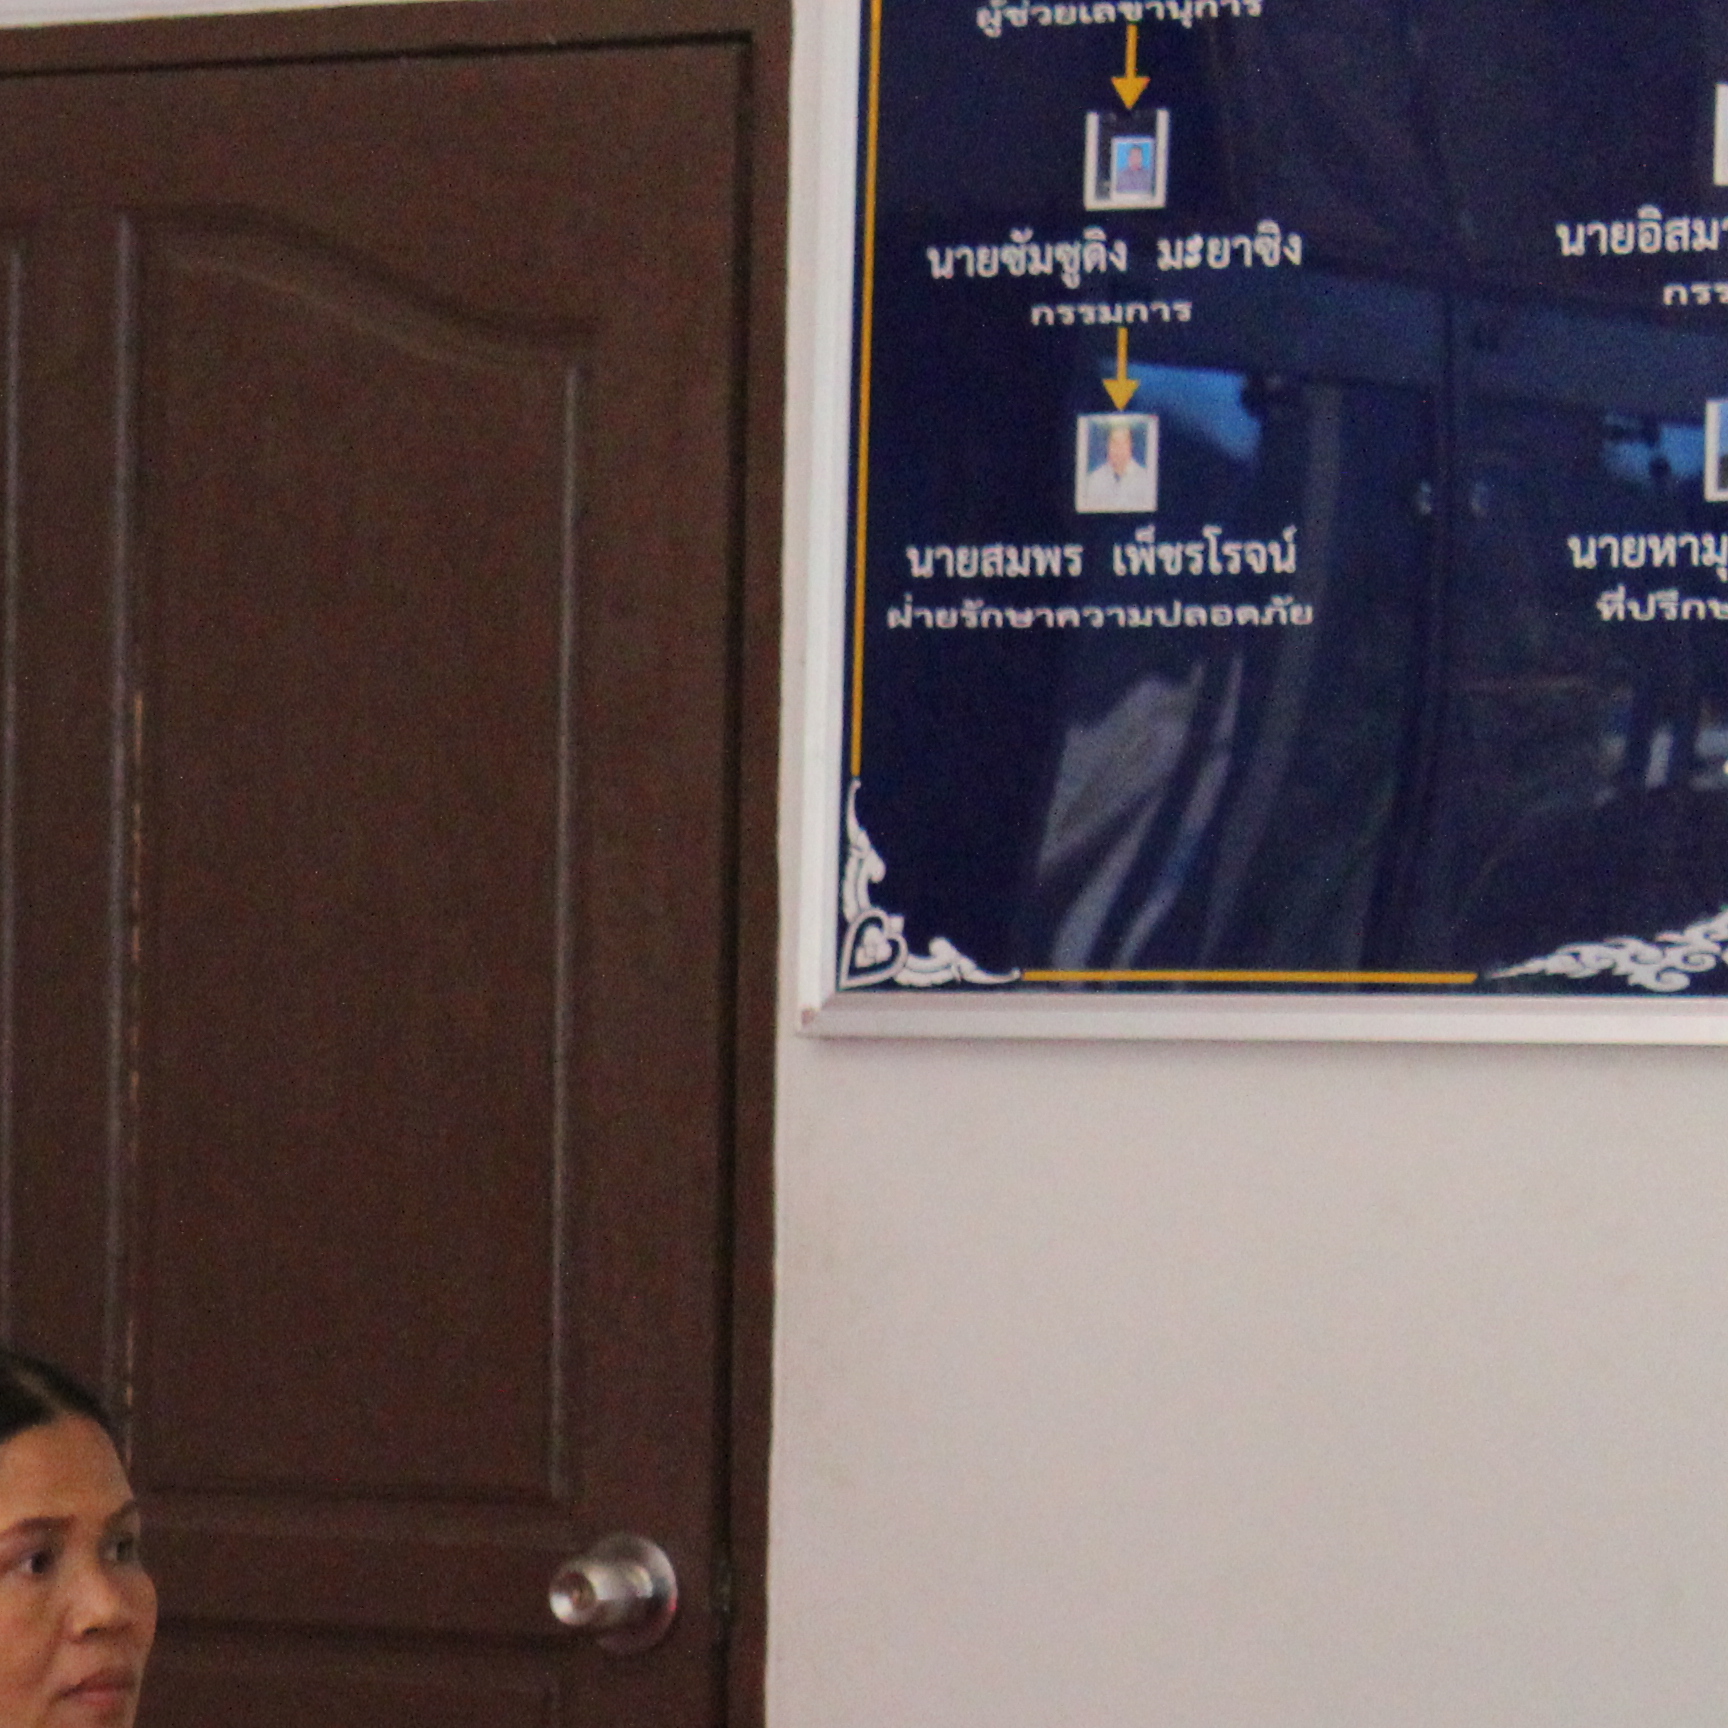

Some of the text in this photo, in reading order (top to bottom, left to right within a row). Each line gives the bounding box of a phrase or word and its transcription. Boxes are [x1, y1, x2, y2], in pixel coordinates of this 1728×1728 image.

[1030, 301, 1193, 326] กรรมการ
[905, 543, 1084, 578] นายสมพร
[886, 591, 1314, 629] ฝ่ายรักษาความปลอดภัย
